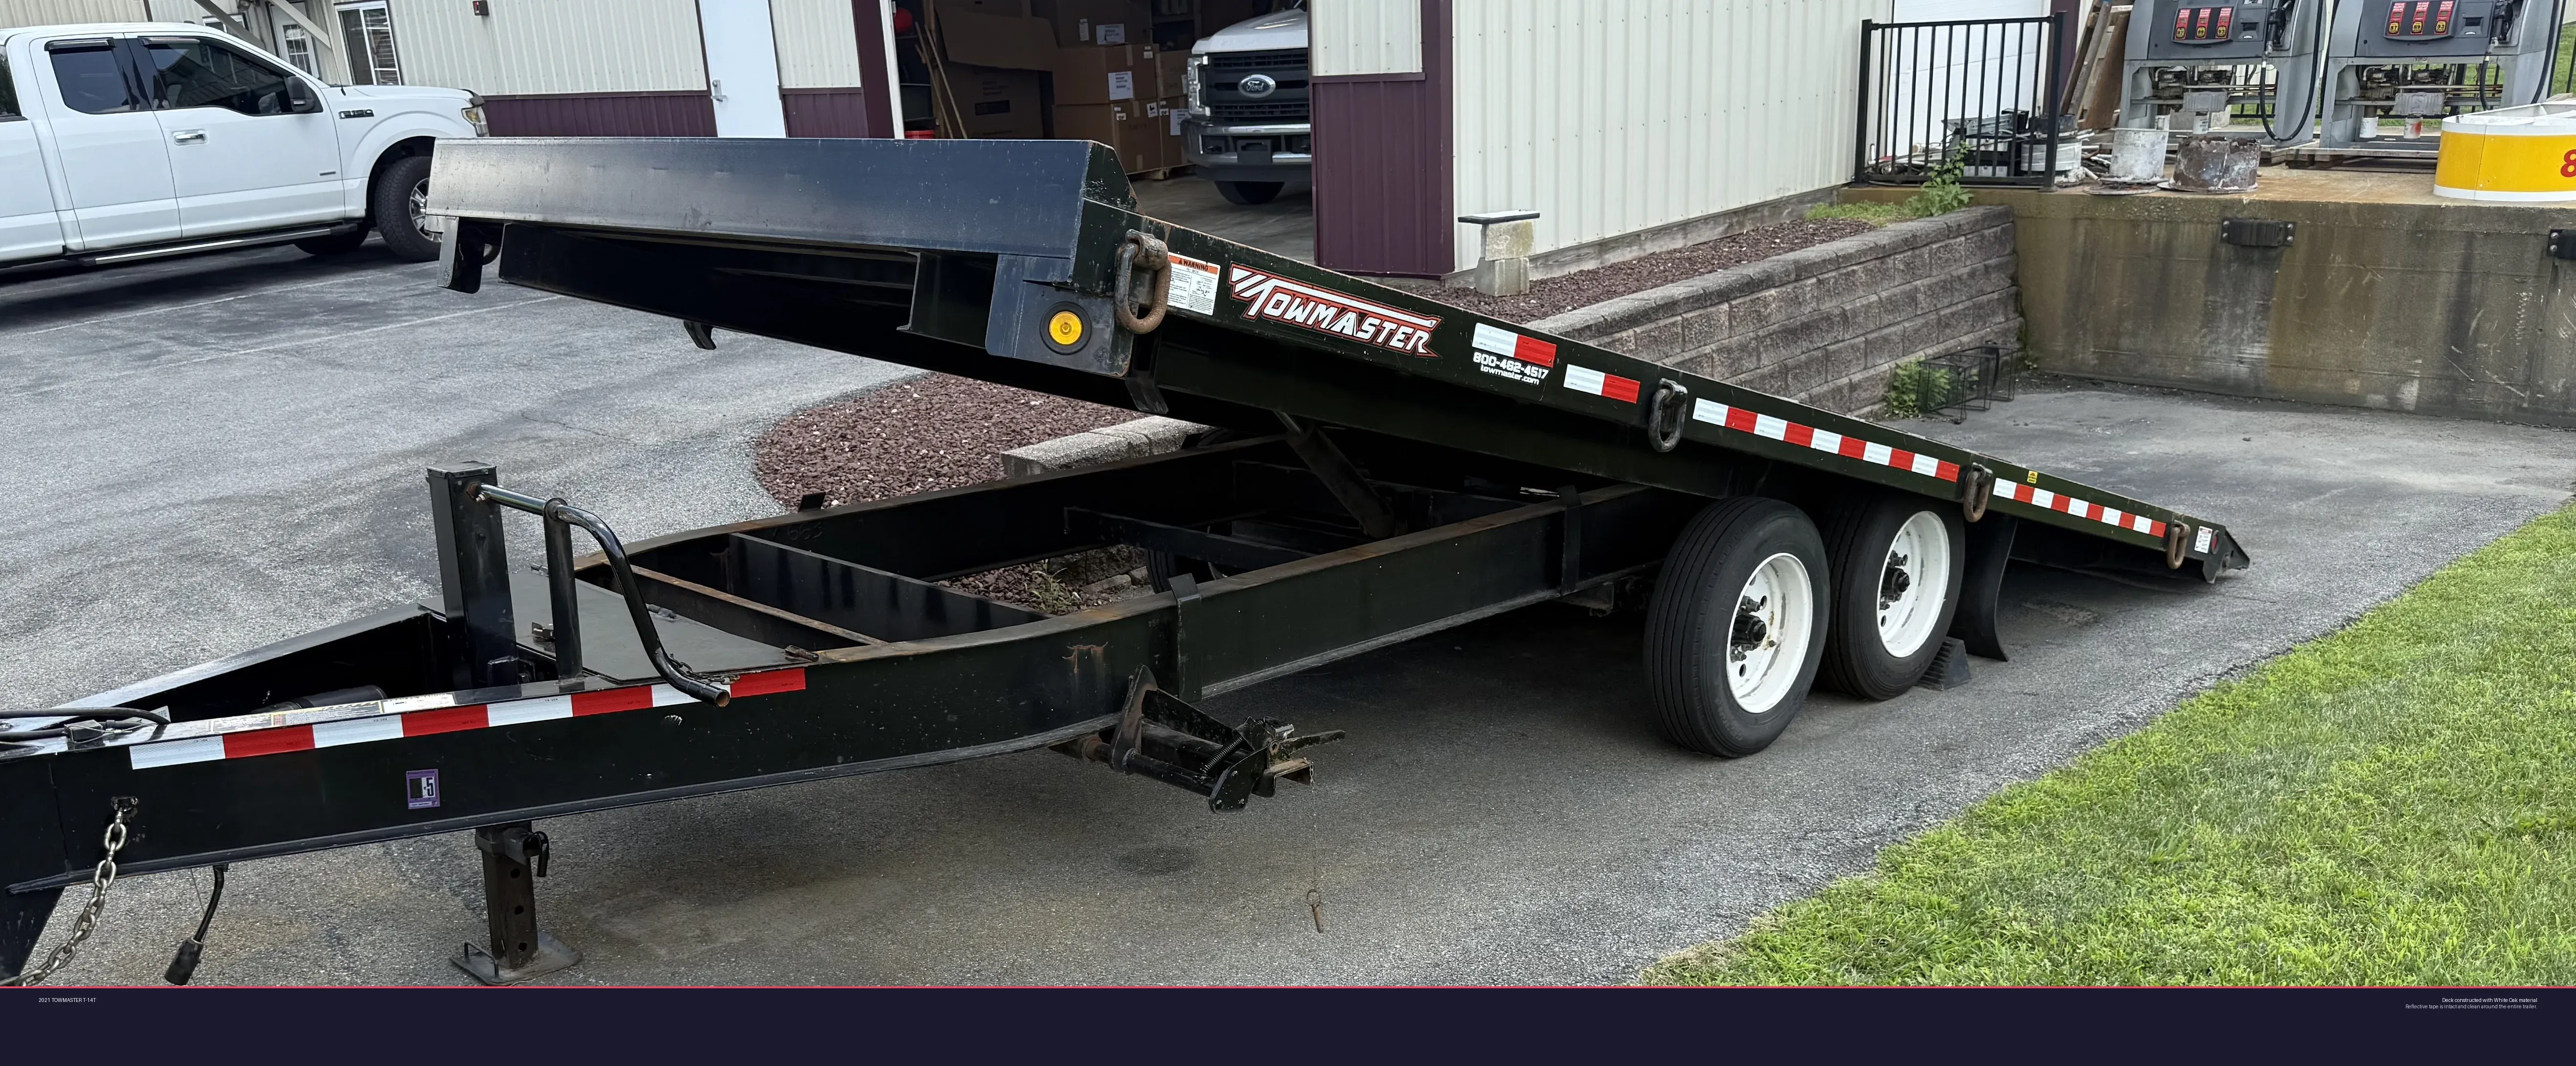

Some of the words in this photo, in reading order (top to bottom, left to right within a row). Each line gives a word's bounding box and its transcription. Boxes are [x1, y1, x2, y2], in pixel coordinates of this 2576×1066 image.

[1246, 81, 1264, 91] Ford
[1184, 260, 1208, 271] WARNING
[1231, 267, 1437, 354] TOWMASTER
[1473, 351, 1549, 379] 800-462-4517
[1480, 364, 1539, 385] towmaster.com
